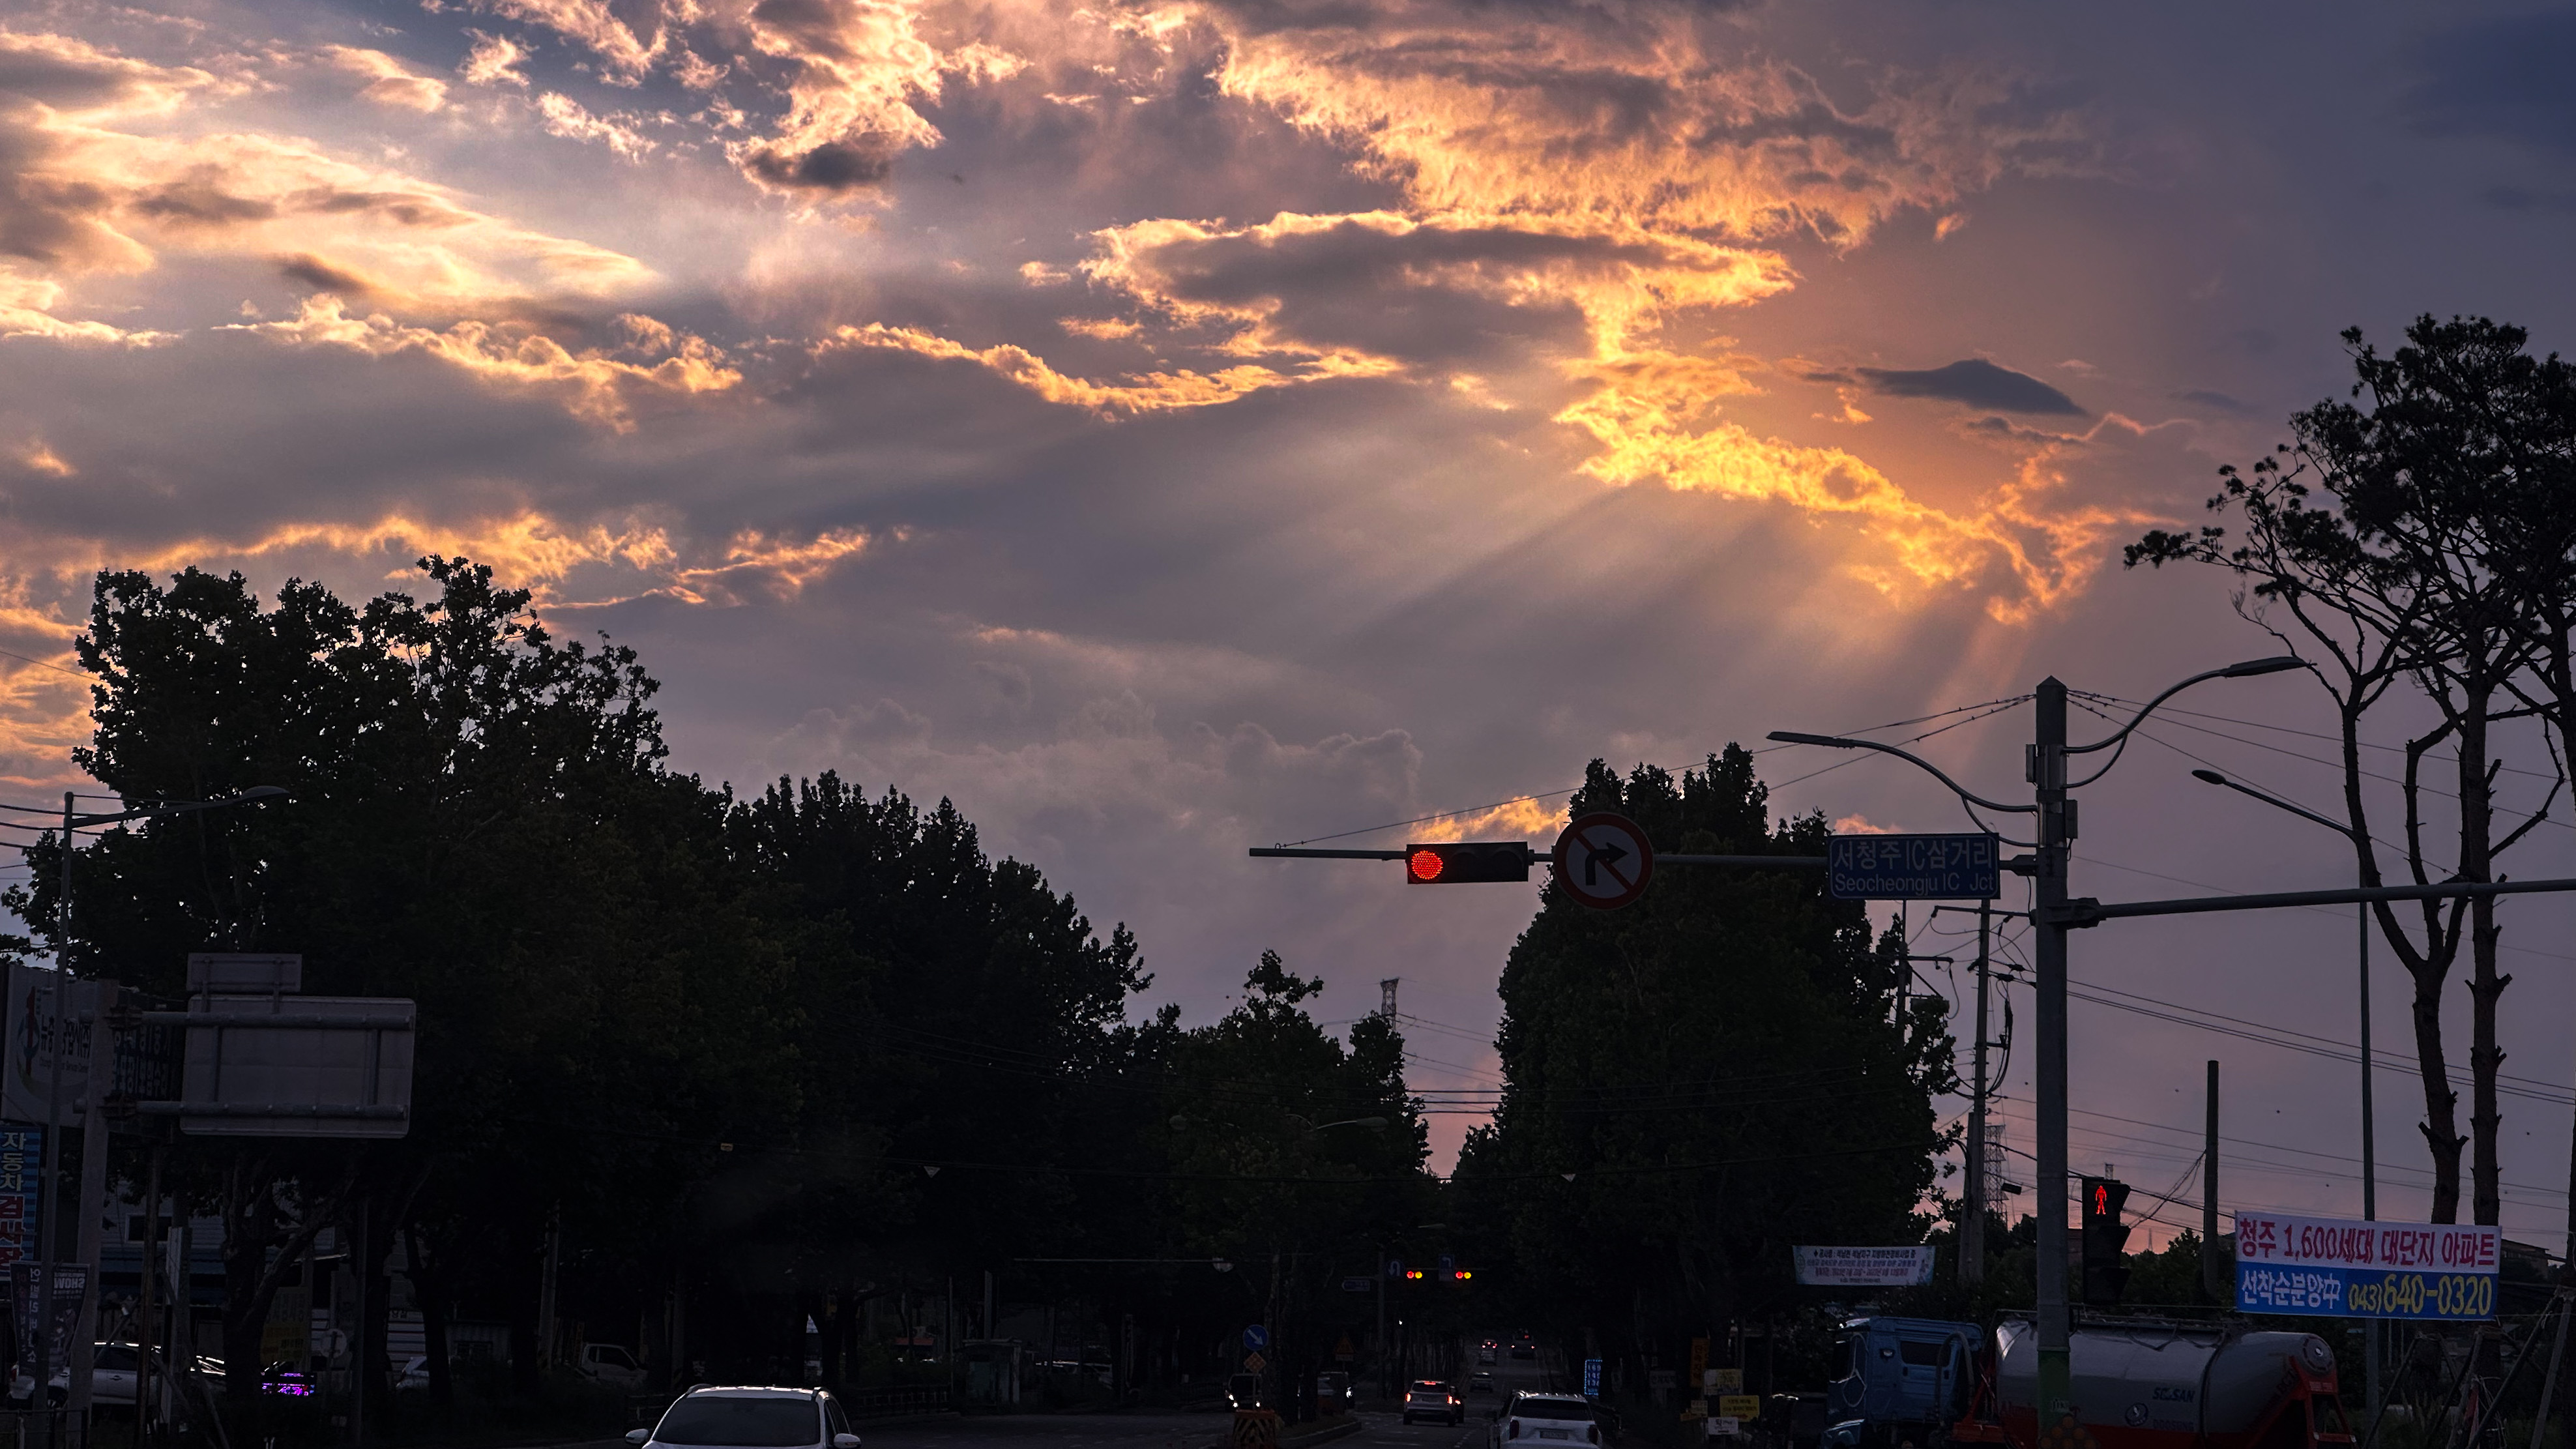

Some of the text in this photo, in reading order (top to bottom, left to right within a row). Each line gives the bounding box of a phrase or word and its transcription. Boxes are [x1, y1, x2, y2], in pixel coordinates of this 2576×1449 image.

[1834, 838, 1993, 871] 서청주IC삼거리
[1834, 872, 1995, 896] Seocheongju IC Jct
[0, 1132, 27, 1192] 자동차
[2239, 1218, 2495, 1268] 청주 1,600세대 대단지 아파트
[2241, 1270, 2341, 1310] 선착순분양中
